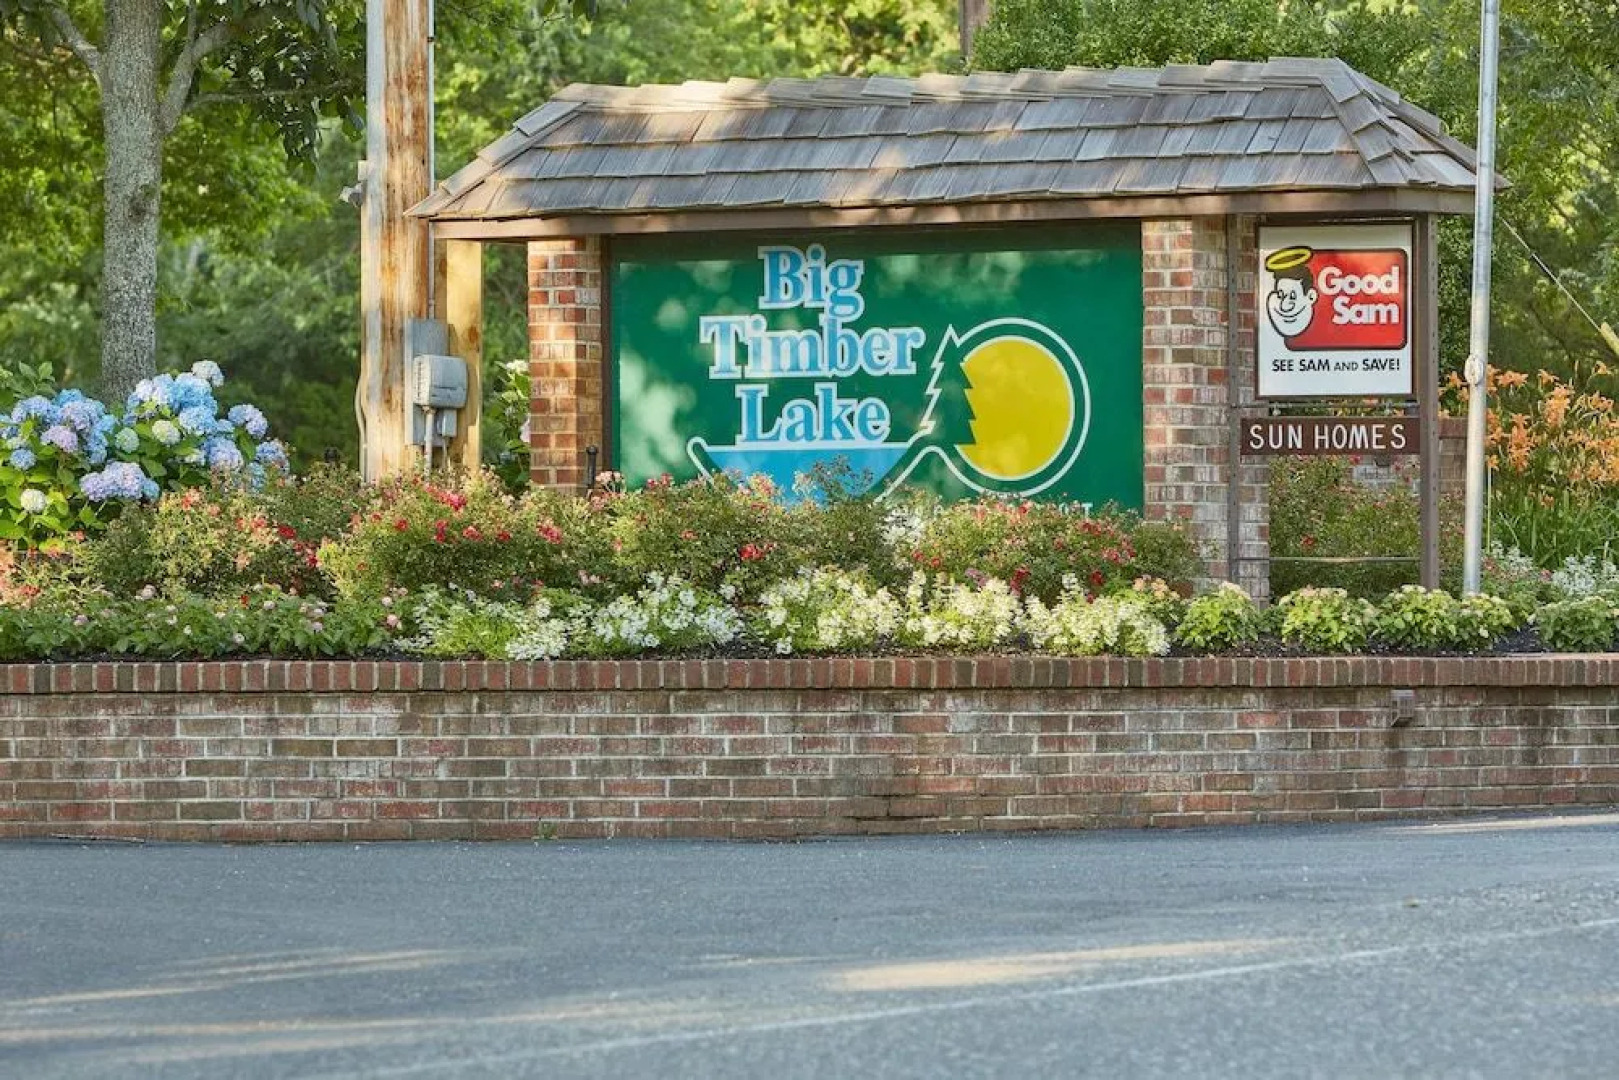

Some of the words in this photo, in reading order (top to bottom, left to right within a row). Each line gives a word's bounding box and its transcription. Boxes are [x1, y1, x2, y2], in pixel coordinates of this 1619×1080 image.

[758, 244, 864, 322] Big
[1317, 265, 1400, 296] Good
[1332, 296, 1399, 325] Sam
[700, 314, 926, 379] Timber
[1272, 359, 1294, 372] SEE
[1299, 358, 1330, 371] SAM
[1334, 362, 1358, 371] AND
[1362, 358, 1400, 371] SAVE!
[735, 382, 891, 443] Lake
[1249, 424, 1303, 449] SUN
[1314, 423, 1406, 449] HOMES
